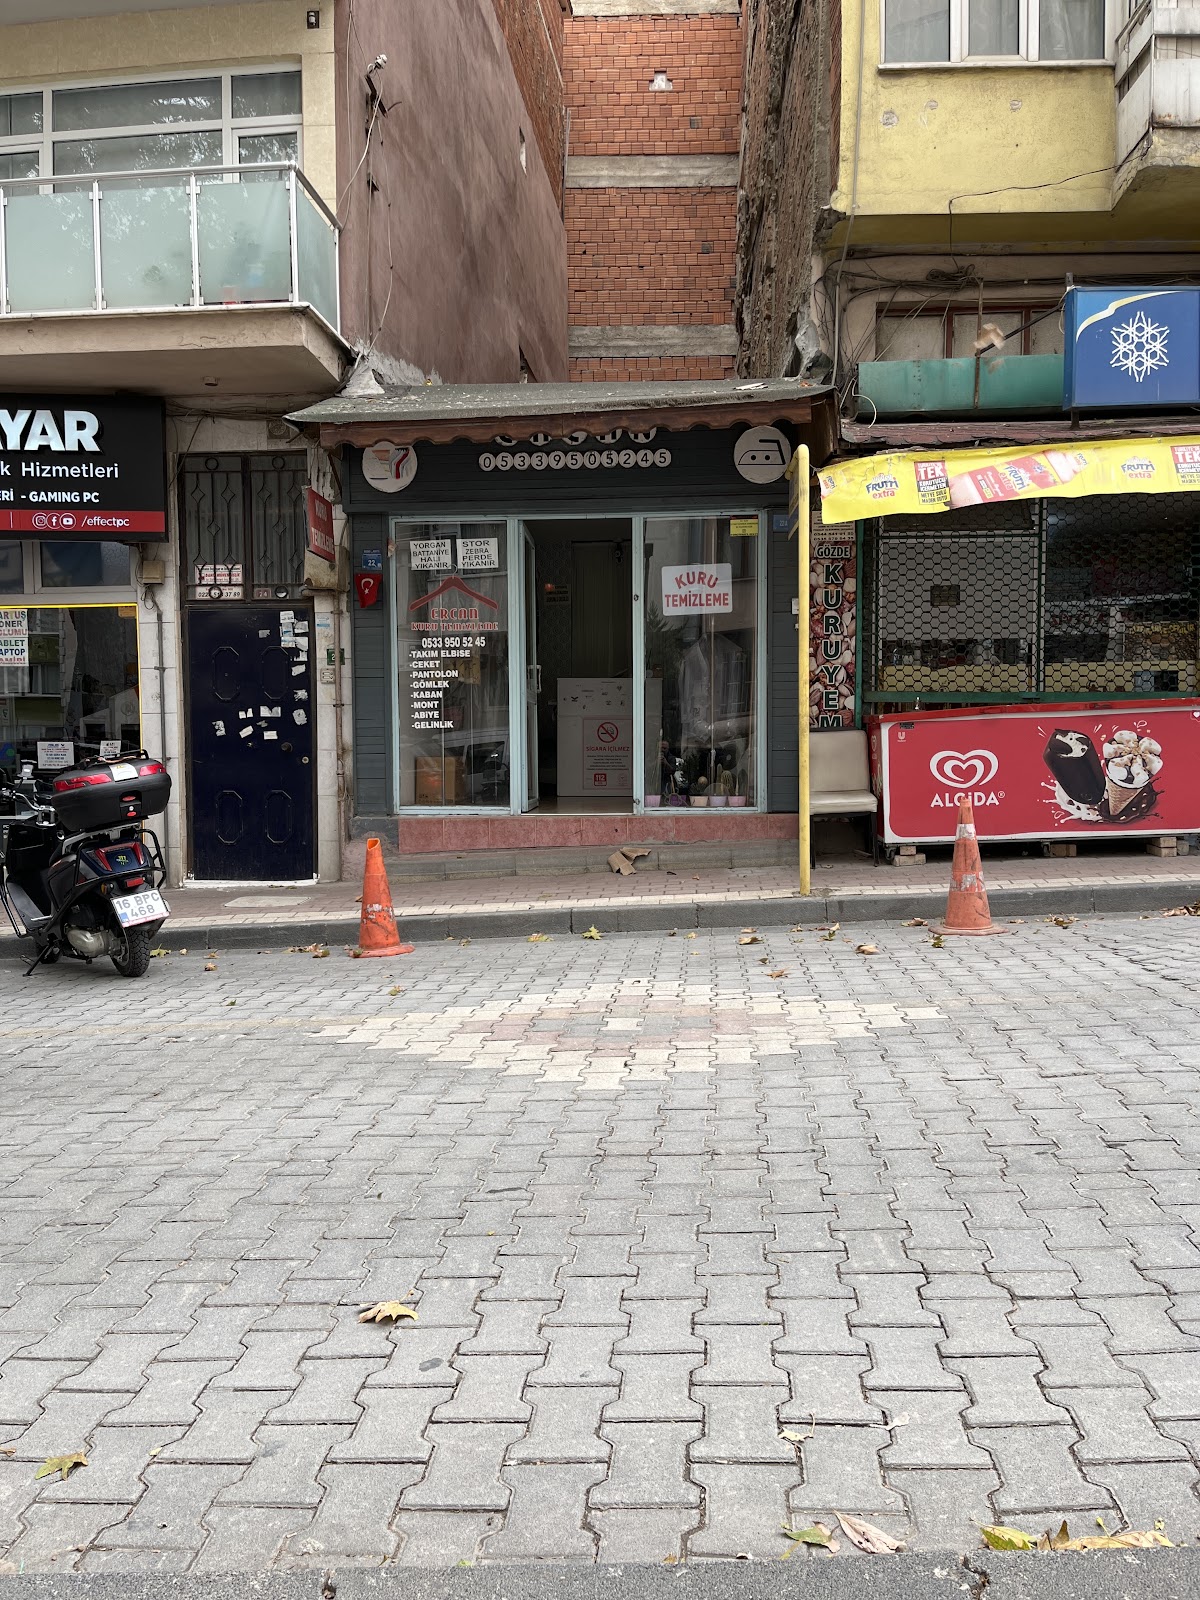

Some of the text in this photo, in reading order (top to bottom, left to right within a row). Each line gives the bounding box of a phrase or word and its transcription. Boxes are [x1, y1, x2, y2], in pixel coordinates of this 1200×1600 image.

[0, 409, 101, 451] YAR
[481, 451, 669, 470] 05339505245
[21, 461, 119, 478] Hizmetleri
[918, 464, 945, 480] TEK
[29, 491, 80, 503] GAMING
[83, 492, 100, 503] PC
[873, 488, 895, 499] extra
[81, 515, 130, 528] /effectpc
[412, 549, 449, 557] BATTANİYE
[817, 544, 849, 557] GÖZDE
[675, 571, 718, 589] KURU
[665, 590, 729, 607] TEMİZLEME
[431, 607, 479, 620] ERCAN
[411, 622, 438, 631] KURU
[421, 637, 486, 648] 0533 950 52 45
[409, 650, 438, 658] -TAKIM
[409, 660, 440, 668] -CEKET
[410, 670, 459, 678] -PANTOLON
[410, 680, 449, 688] -GÖMLEK
[410, 691, 443, 699] -KABAN
[411, 701, 439, 709] -MONT
[116, 892, 160, 910] 16 BPC
[131, 904, 155, 917] 468
